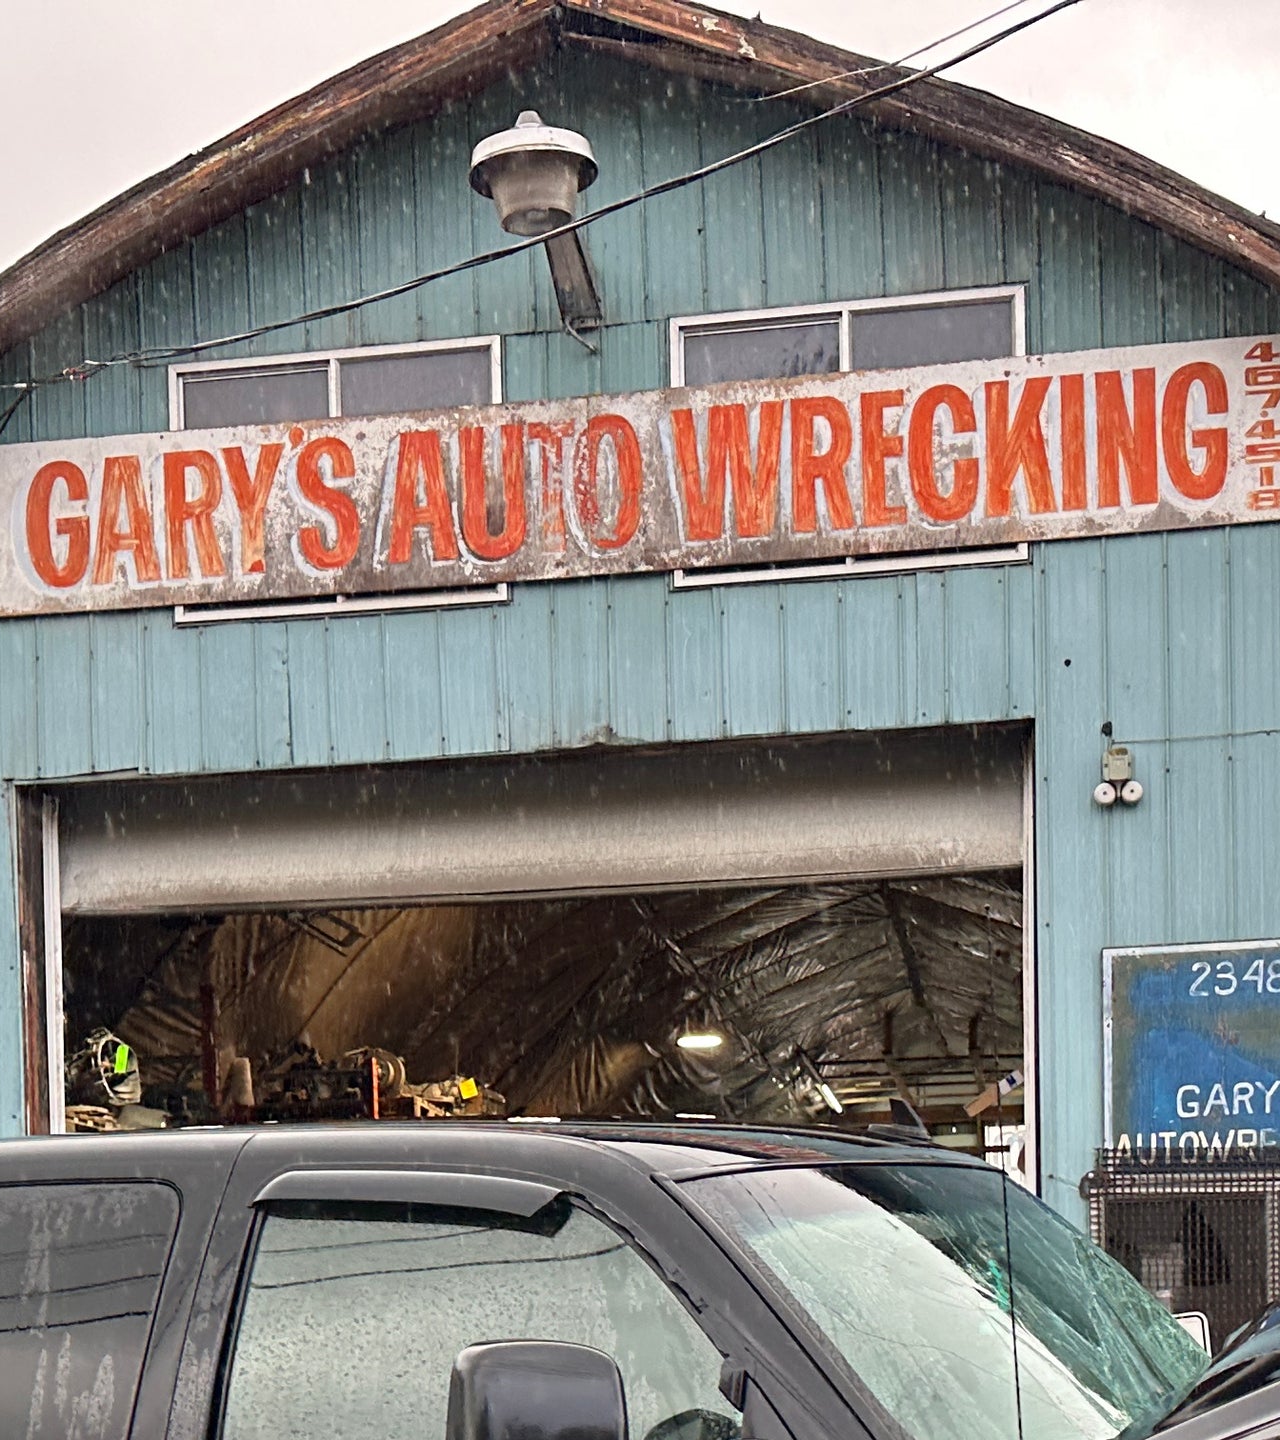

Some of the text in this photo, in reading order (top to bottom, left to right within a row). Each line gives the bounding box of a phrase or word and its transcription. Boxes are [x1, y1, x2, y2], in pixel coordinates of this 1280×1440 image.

[24, 361, 1230, 589] GARY'S AUTO WRECKING
